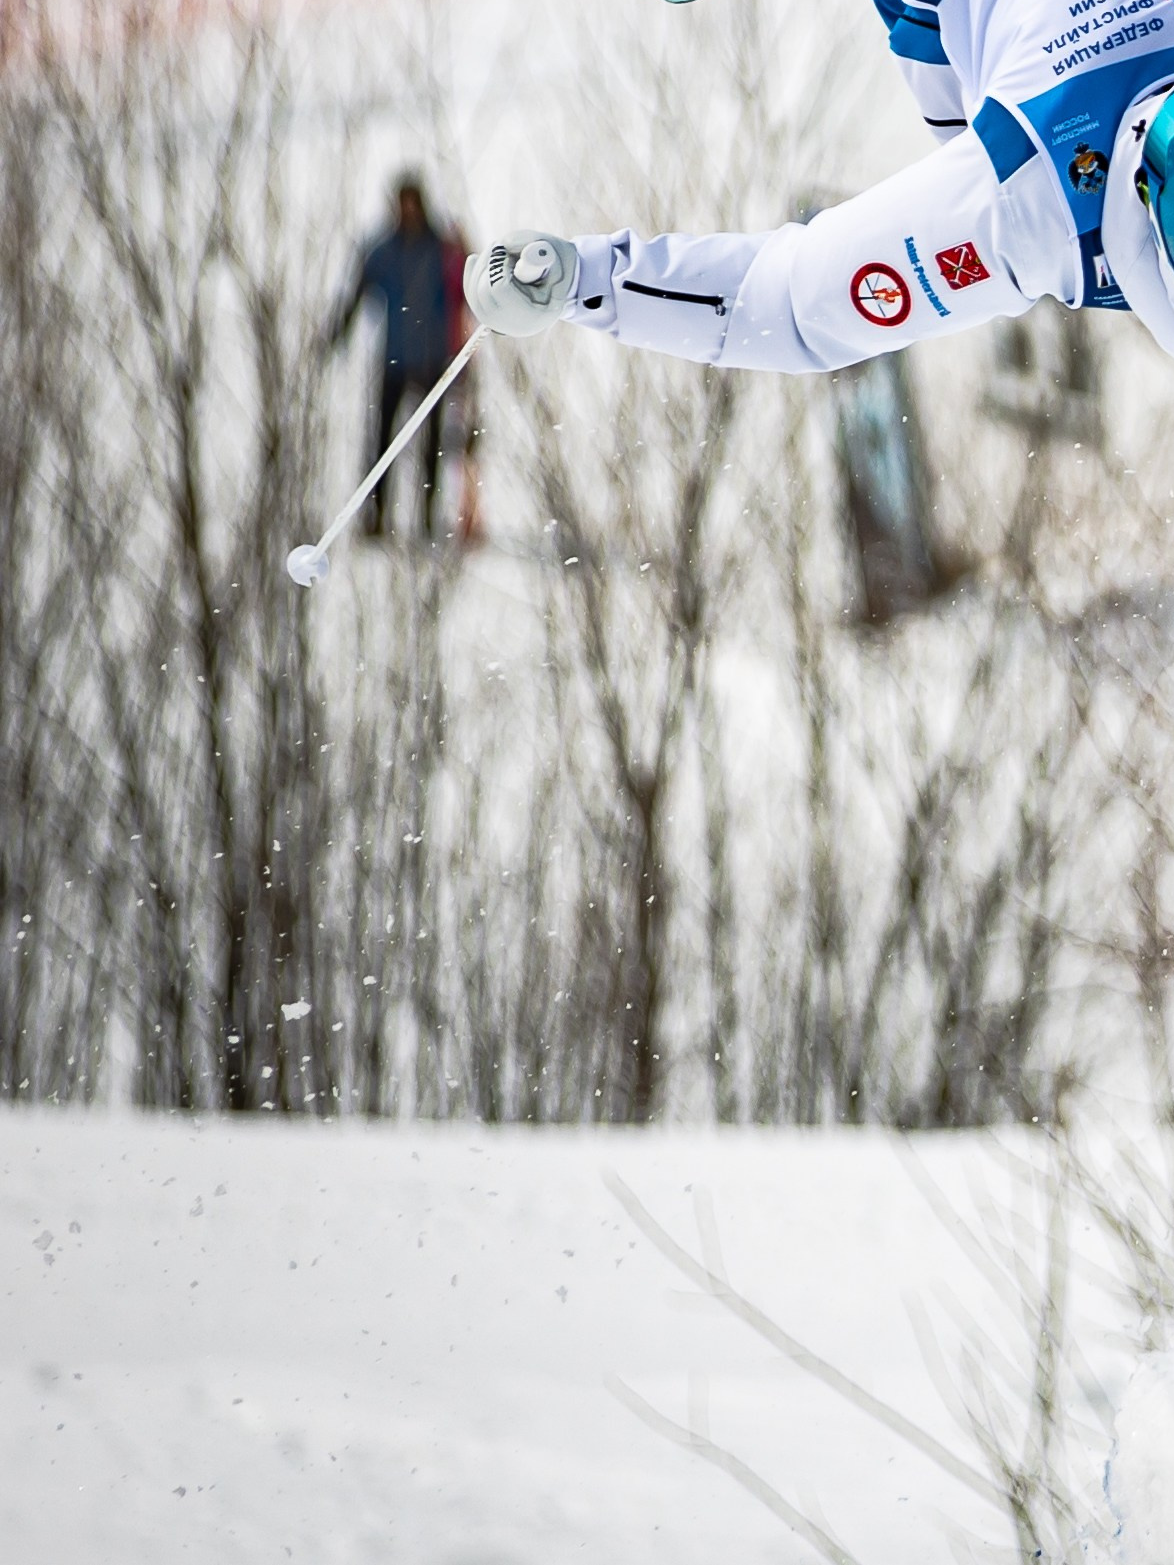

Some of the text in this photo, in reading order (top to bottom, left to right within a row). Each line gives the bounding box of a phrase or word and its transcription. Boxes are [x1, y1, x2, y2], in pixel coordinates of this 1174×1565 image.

[1052, 18, 1164, 76] ФЕДЕРАЦИЯ
[1051, 120, 1100, 146] МИНСПОРТ
[1052, 112, 1090, 133] РОССИИ
